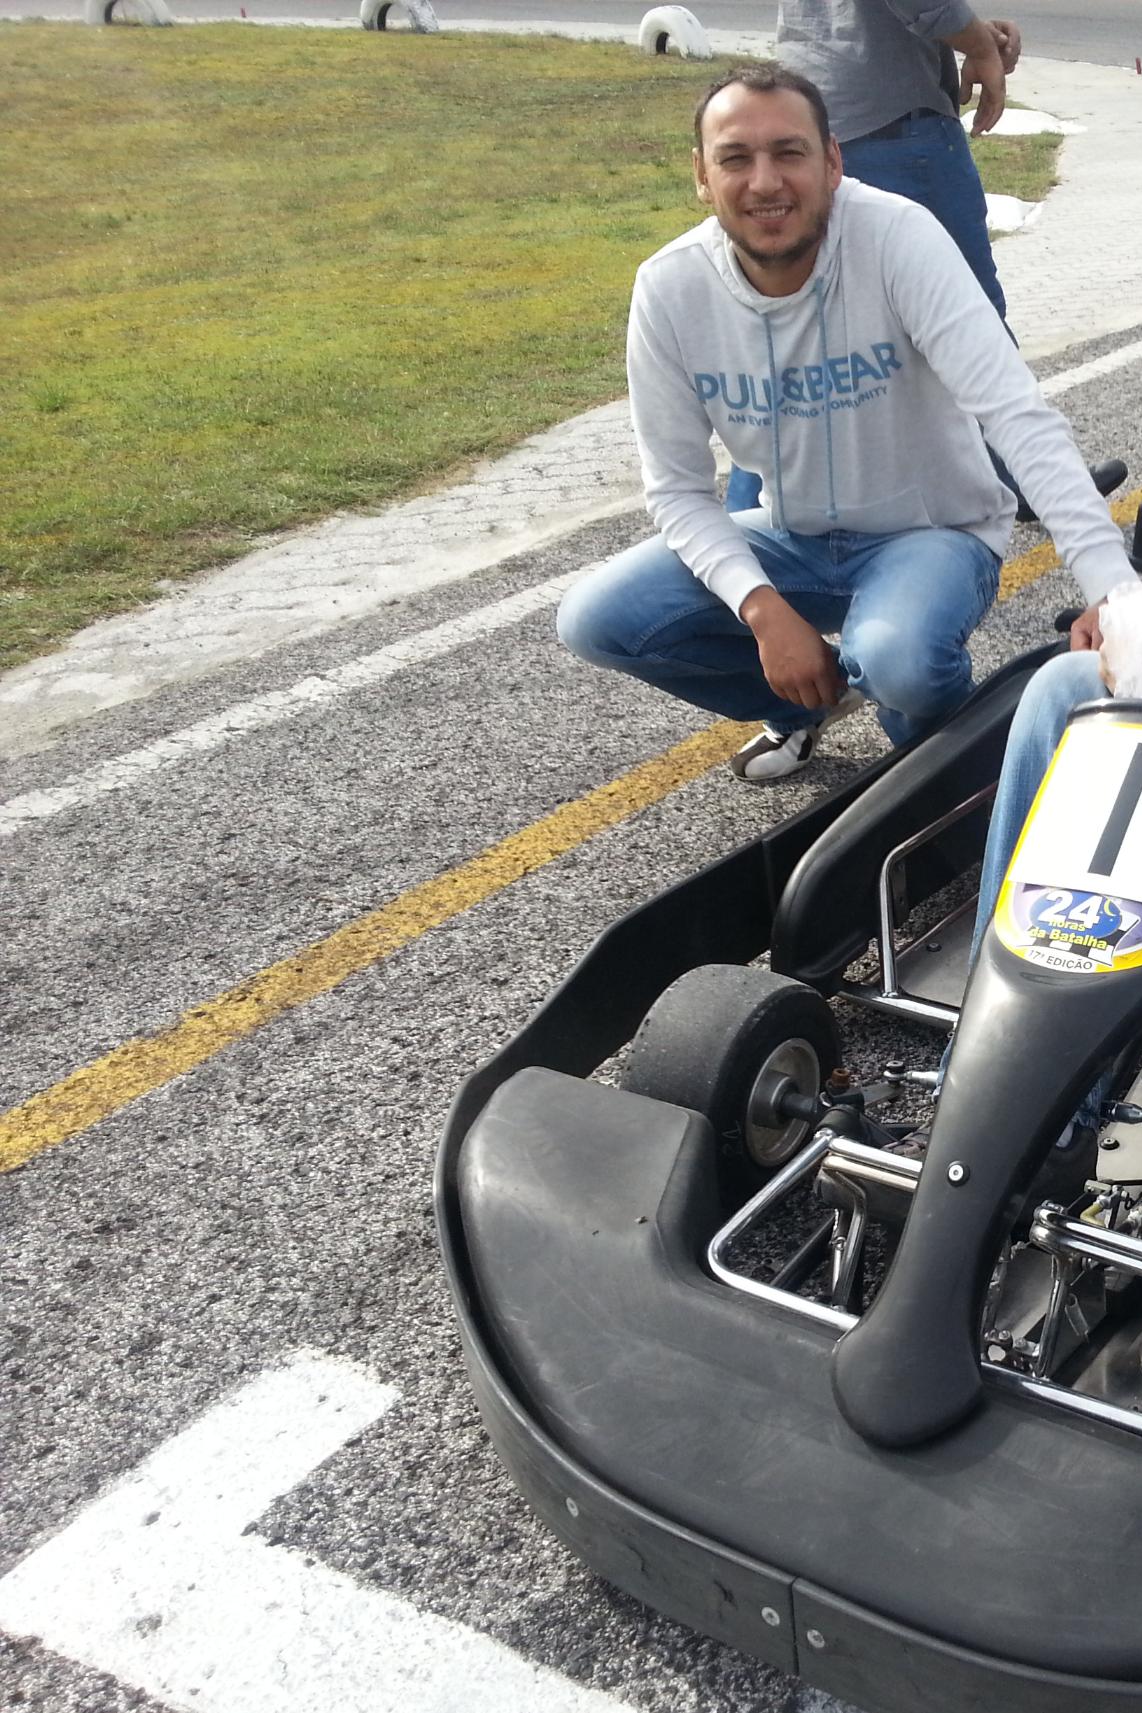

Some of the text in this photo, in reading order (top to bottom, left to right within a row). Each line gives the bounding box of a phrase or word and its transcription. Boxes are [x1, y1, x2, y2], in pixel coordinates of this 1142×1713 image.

[693, 341, 903, 413] PULL&BEAR
[1037, 890, 1103, 929] 24
[1048, 918, 1087, 932] horas
[1028, 926, 1108, 951] da Batalha
